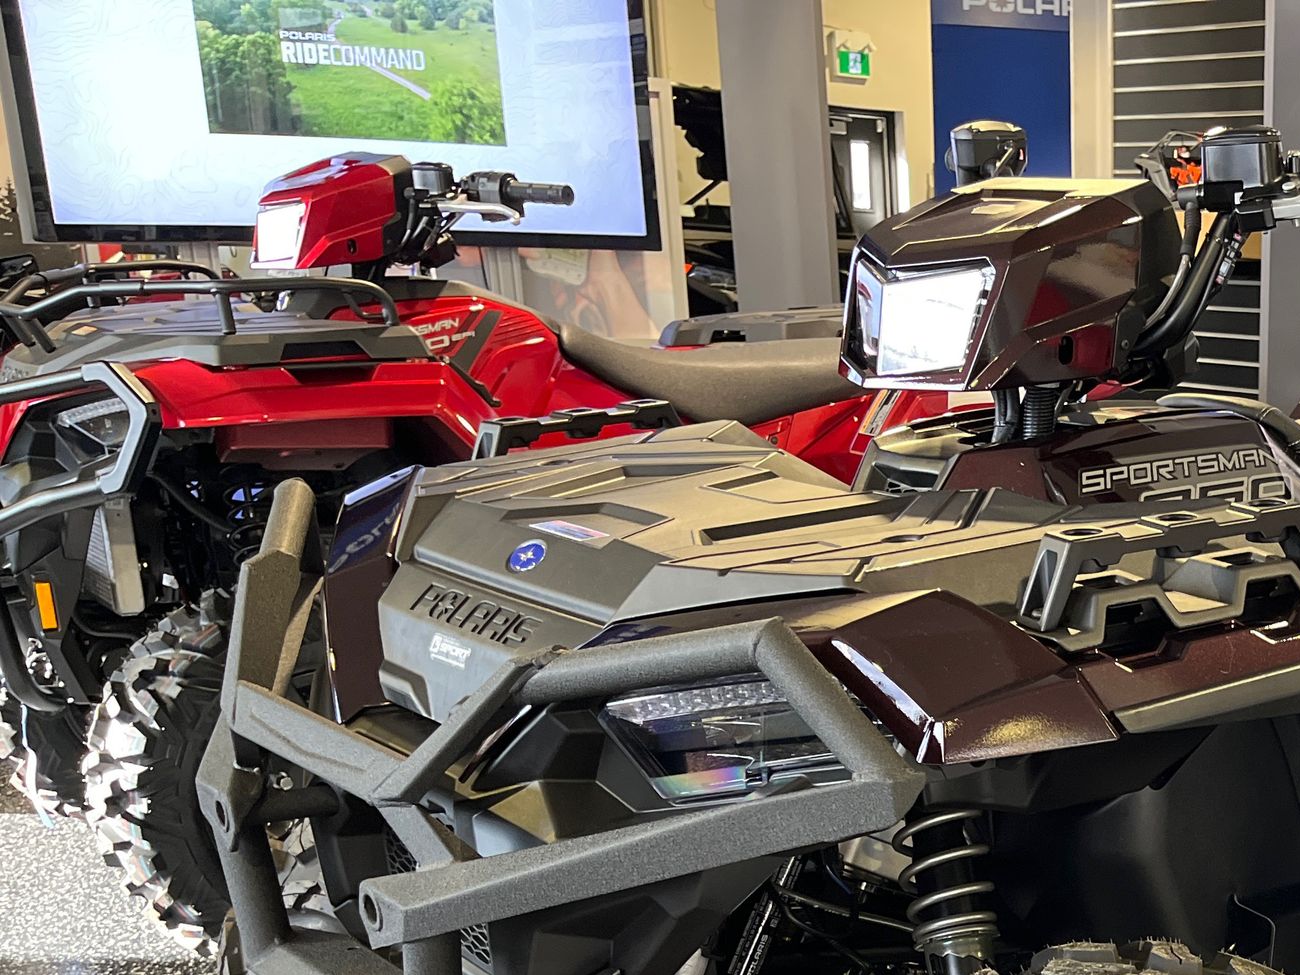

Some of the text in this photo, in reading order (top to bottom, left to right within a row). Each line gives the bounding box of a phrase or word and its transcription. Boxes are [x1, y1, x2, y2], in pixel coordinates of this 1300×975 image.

[279, 31, 336, 41] POLARIS
[1081, 448, 1279, 494] SPORTSMAN
[410, 582, 543, 645] POLARIS
